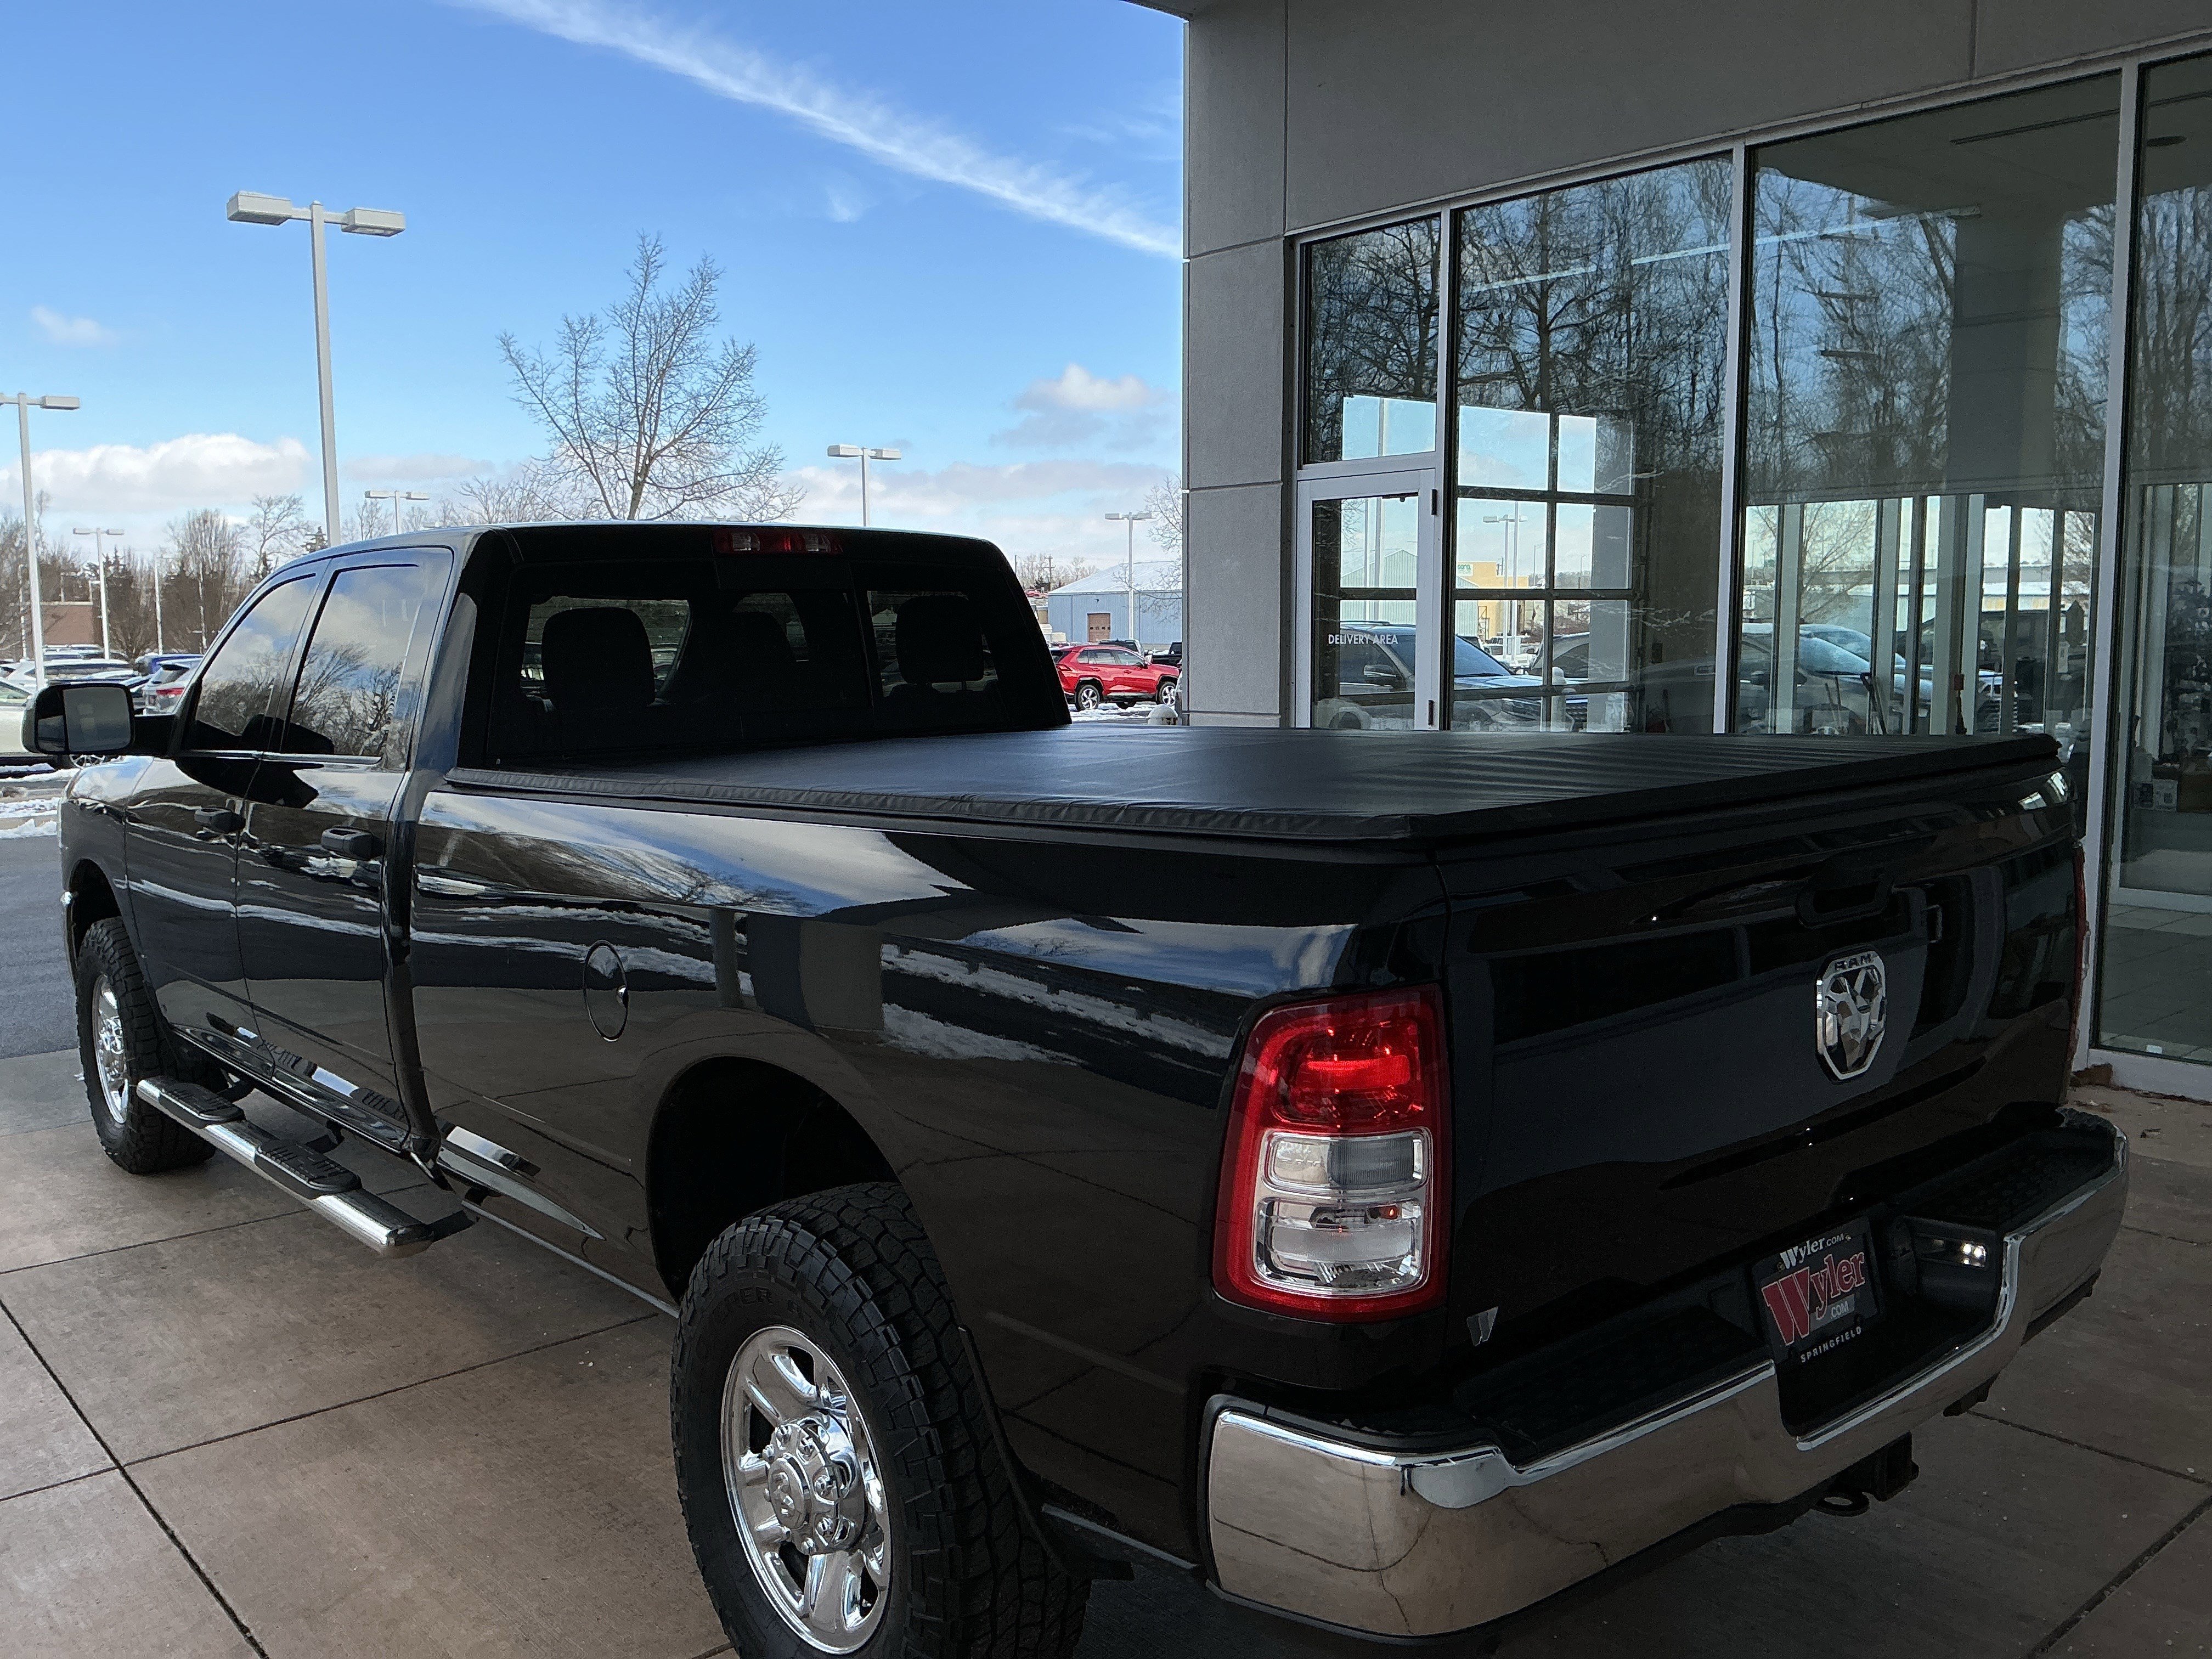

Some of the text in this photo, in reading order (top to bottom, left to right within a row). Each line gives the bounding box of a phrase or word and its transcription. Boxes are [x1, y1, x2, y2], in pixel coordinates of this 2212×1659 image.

[1328, 634, 1398, 645] DELIVERY AREA
[1833, 953, 1874, 971] RAM
[1761, 1251, 1865, 1346] Wyler
[1830, 1301, 1849, 1319] .COM
[1800, 1326, 1862, 1363] SPRINGFIELD
